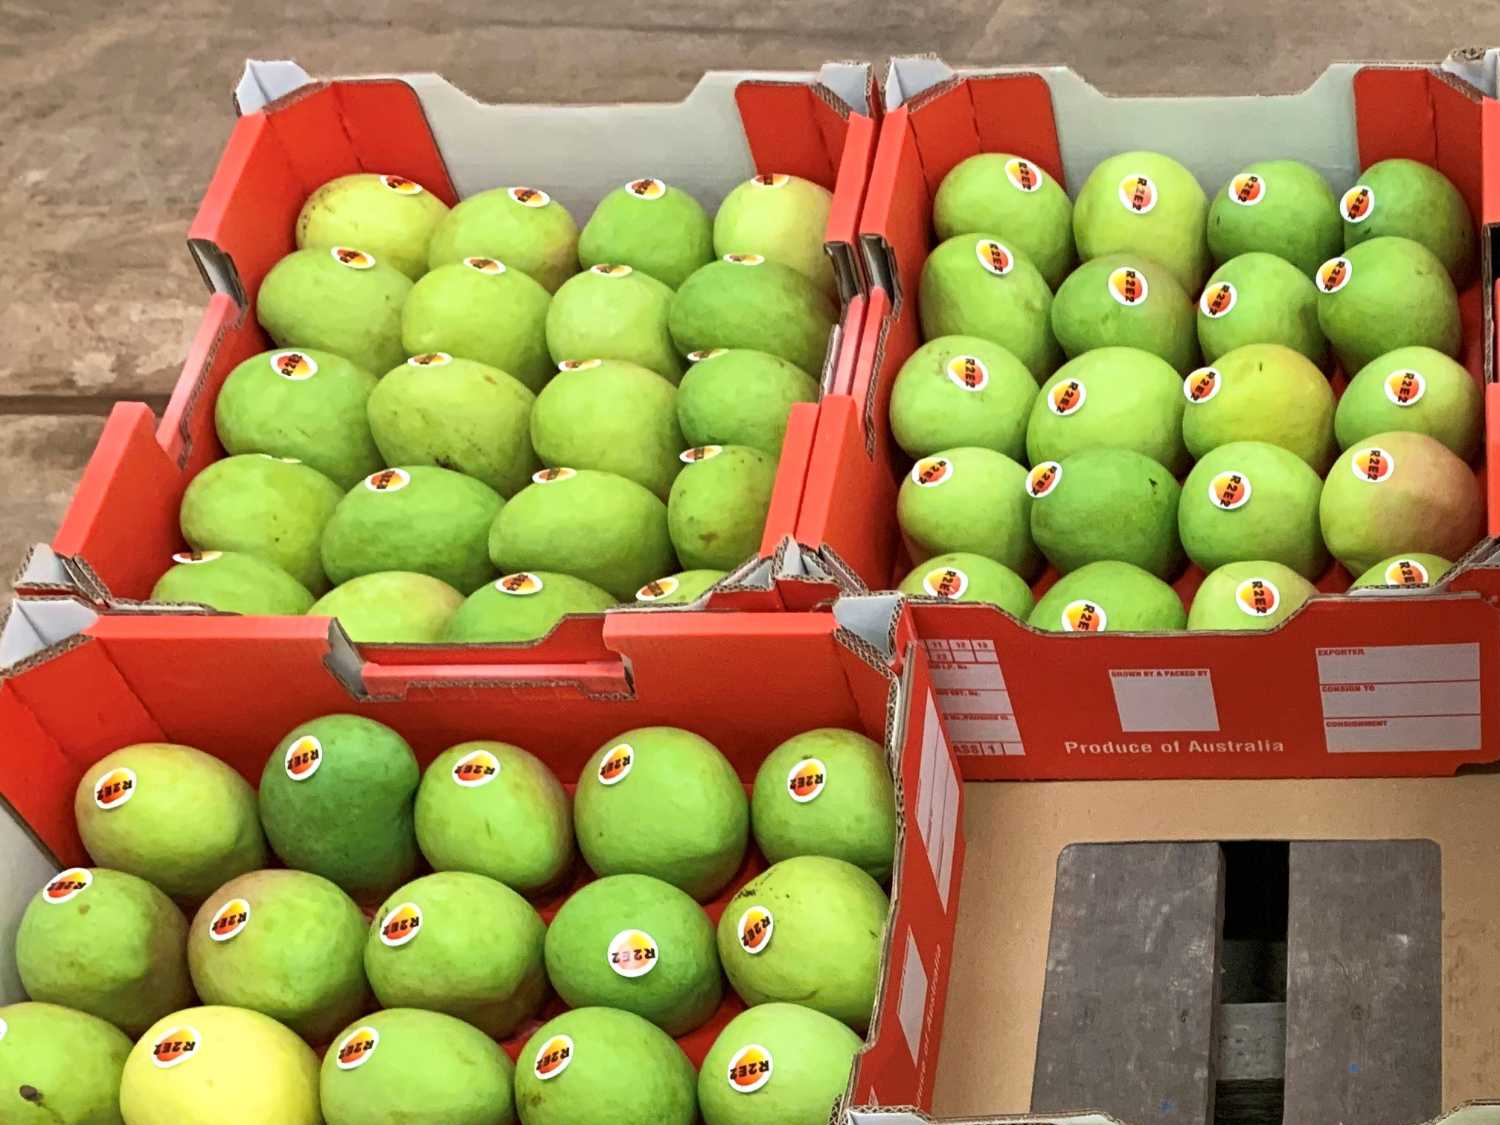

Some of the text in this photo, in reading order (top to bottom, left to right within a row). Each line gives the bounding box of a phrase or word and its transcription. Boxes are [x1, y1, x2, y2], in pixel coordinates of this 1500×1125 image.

[1132, 177, 1148, 211] R2E2
[1237, 176, 1258, 203] R2E2
[1347, 188, 1369, 220] R2E2
[1125, 270, 1136, 303] R2E2
[1324, 261, 1345, 292] R2E2
[1208, 284, 1230, 316] R2E2
[965, 358, 976, 388] R2E2
[1190, 371, 1216, 402] R2E2
[1397, 372, 1415, 403] R2E2
[1056, 381, 1079, 414] R2E2
[1367, 450, 1381, 481] R2E2
[1220, 475, 1242, 508] R2E2
[1399, 561, 1416, 583] R2E
[1252, 581, 1267, 614] R2E2
[1078, 604, 1095, 631] R2E
[287, 748, 319, 770] R2E2
[1064, 738, 1284, 755] Produce of Australia
[789, 773, 824, 790] R2E2
[153, 1041, 196, 1056] R2E2
[729, 1060, 770, 1081] R2E2
